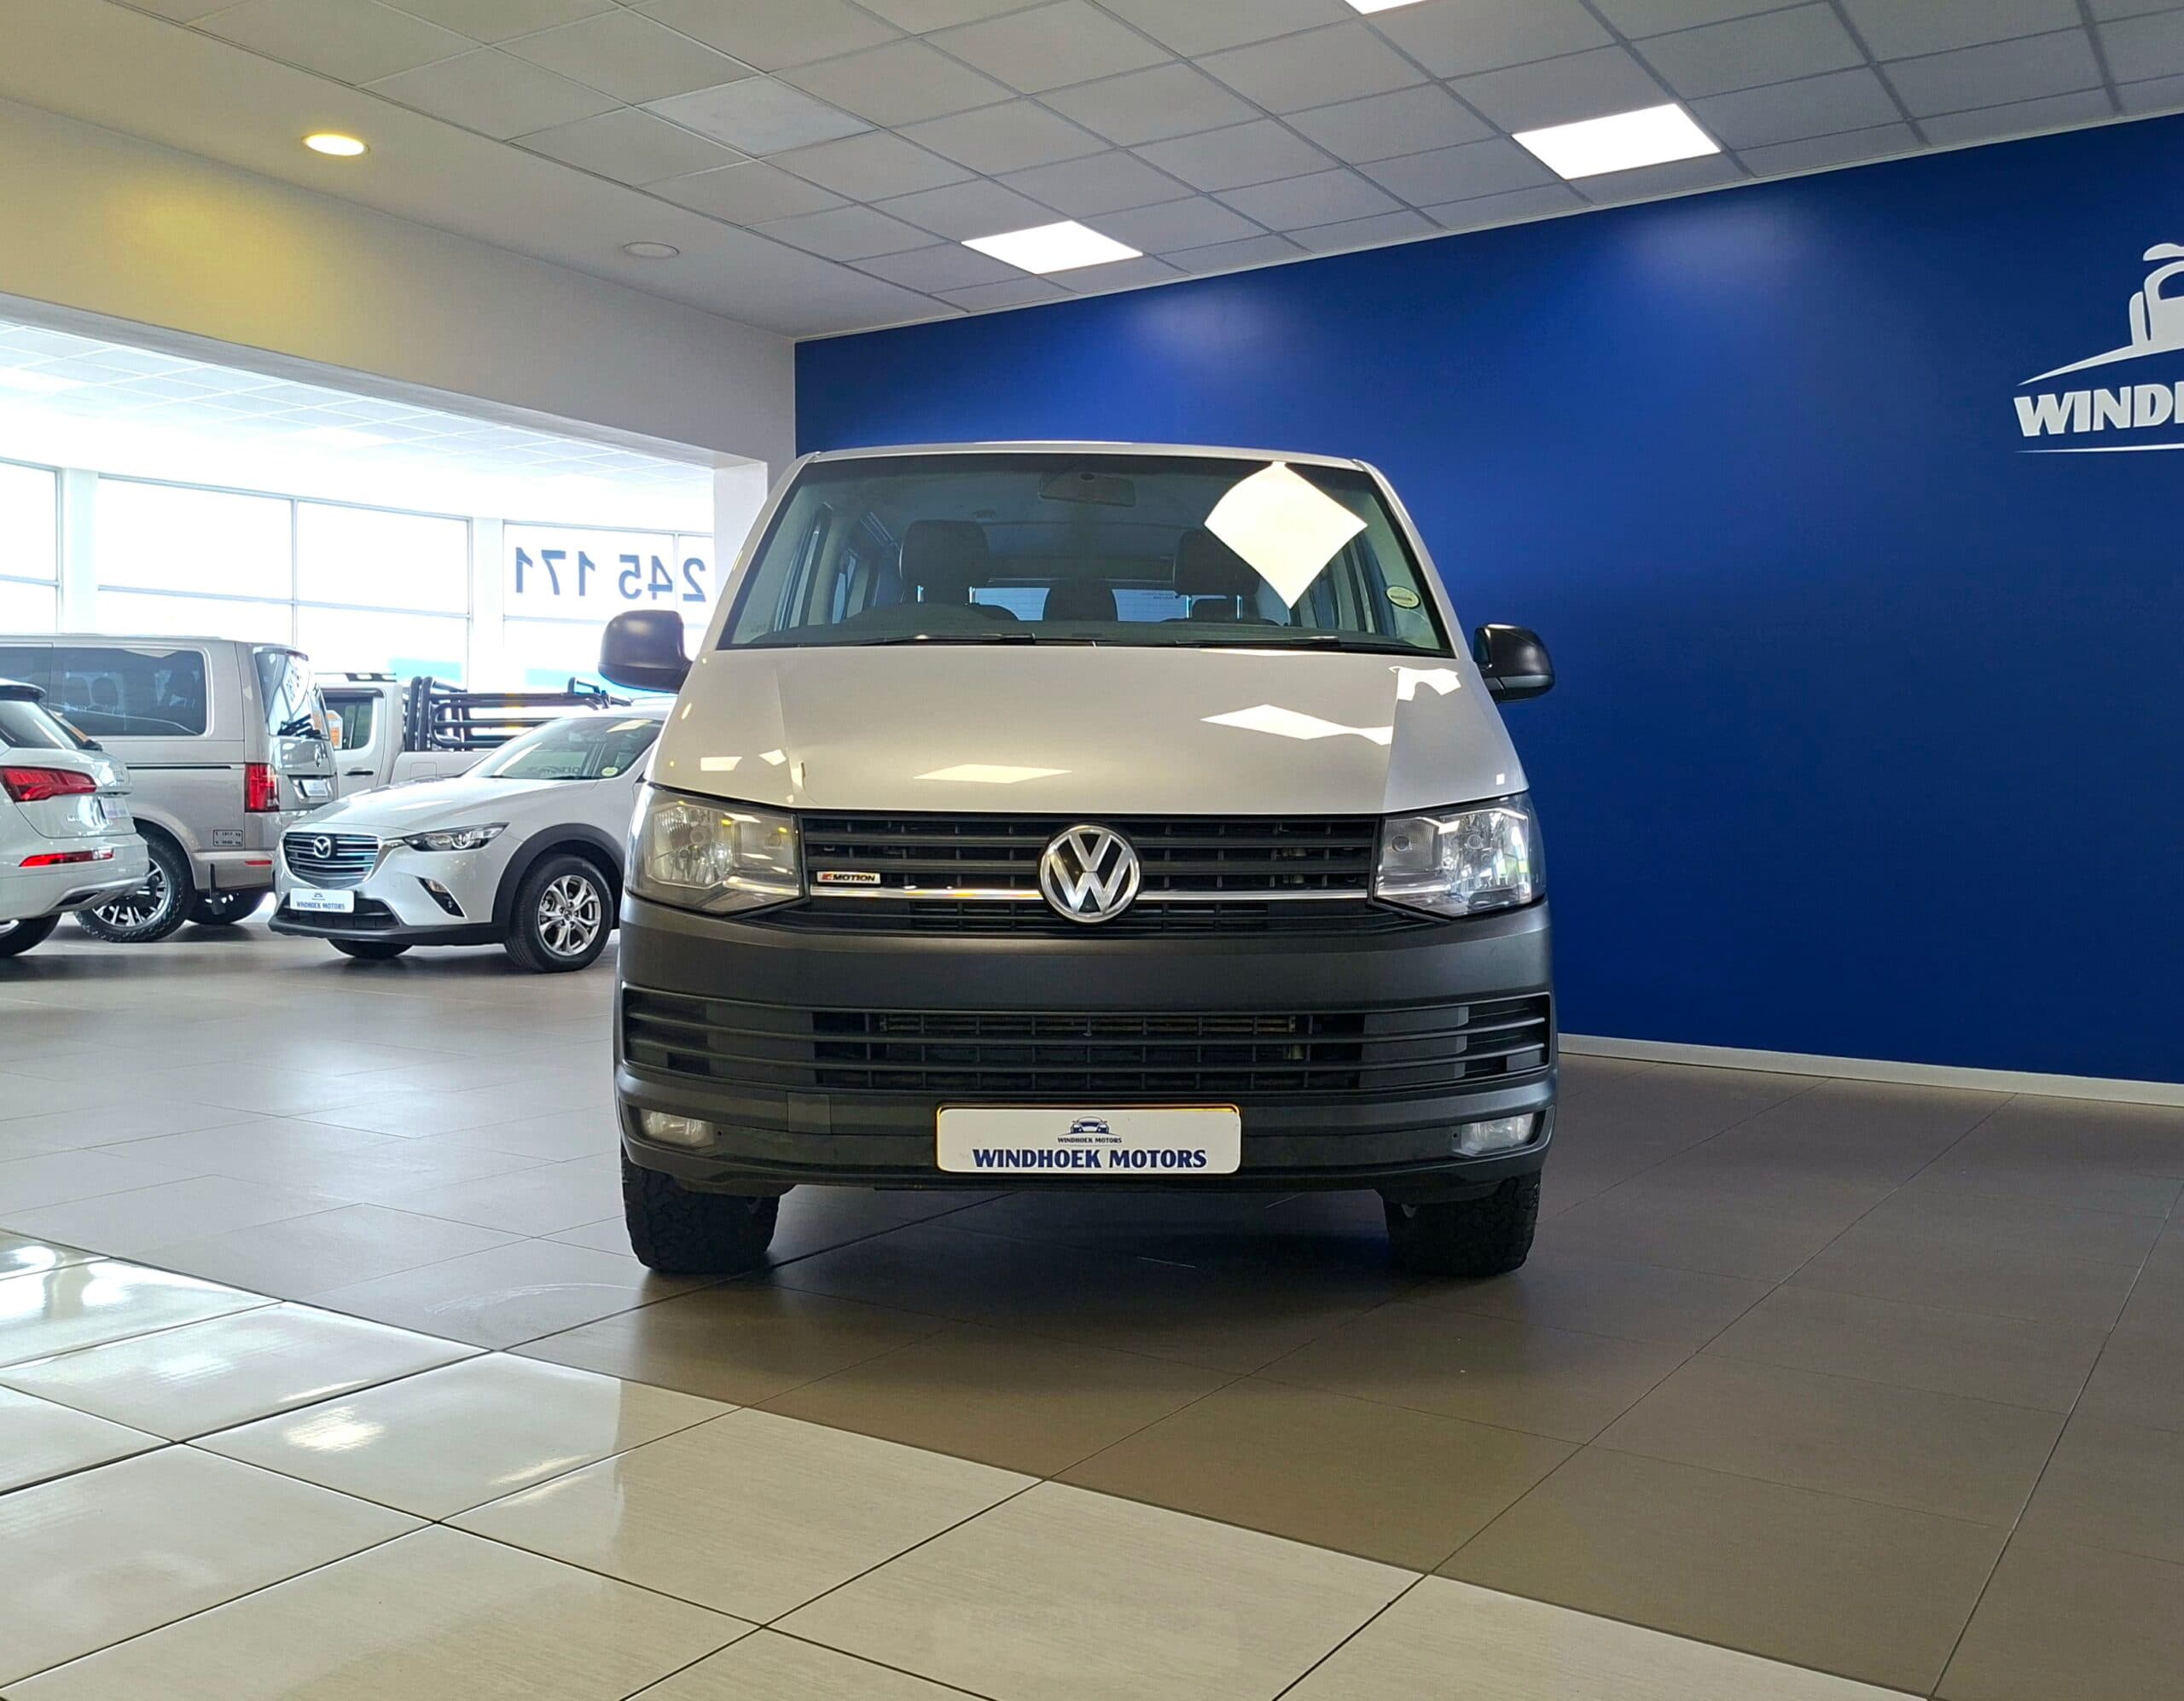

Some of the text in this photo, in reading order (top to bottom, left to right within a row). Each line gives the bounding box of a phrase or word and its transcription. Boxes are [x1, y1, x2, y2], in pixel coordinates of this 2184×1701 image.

[2013, 380, 2184, 437] WIND
[972, 1149, 1207, 1169] WINDHOEK MOTORS
